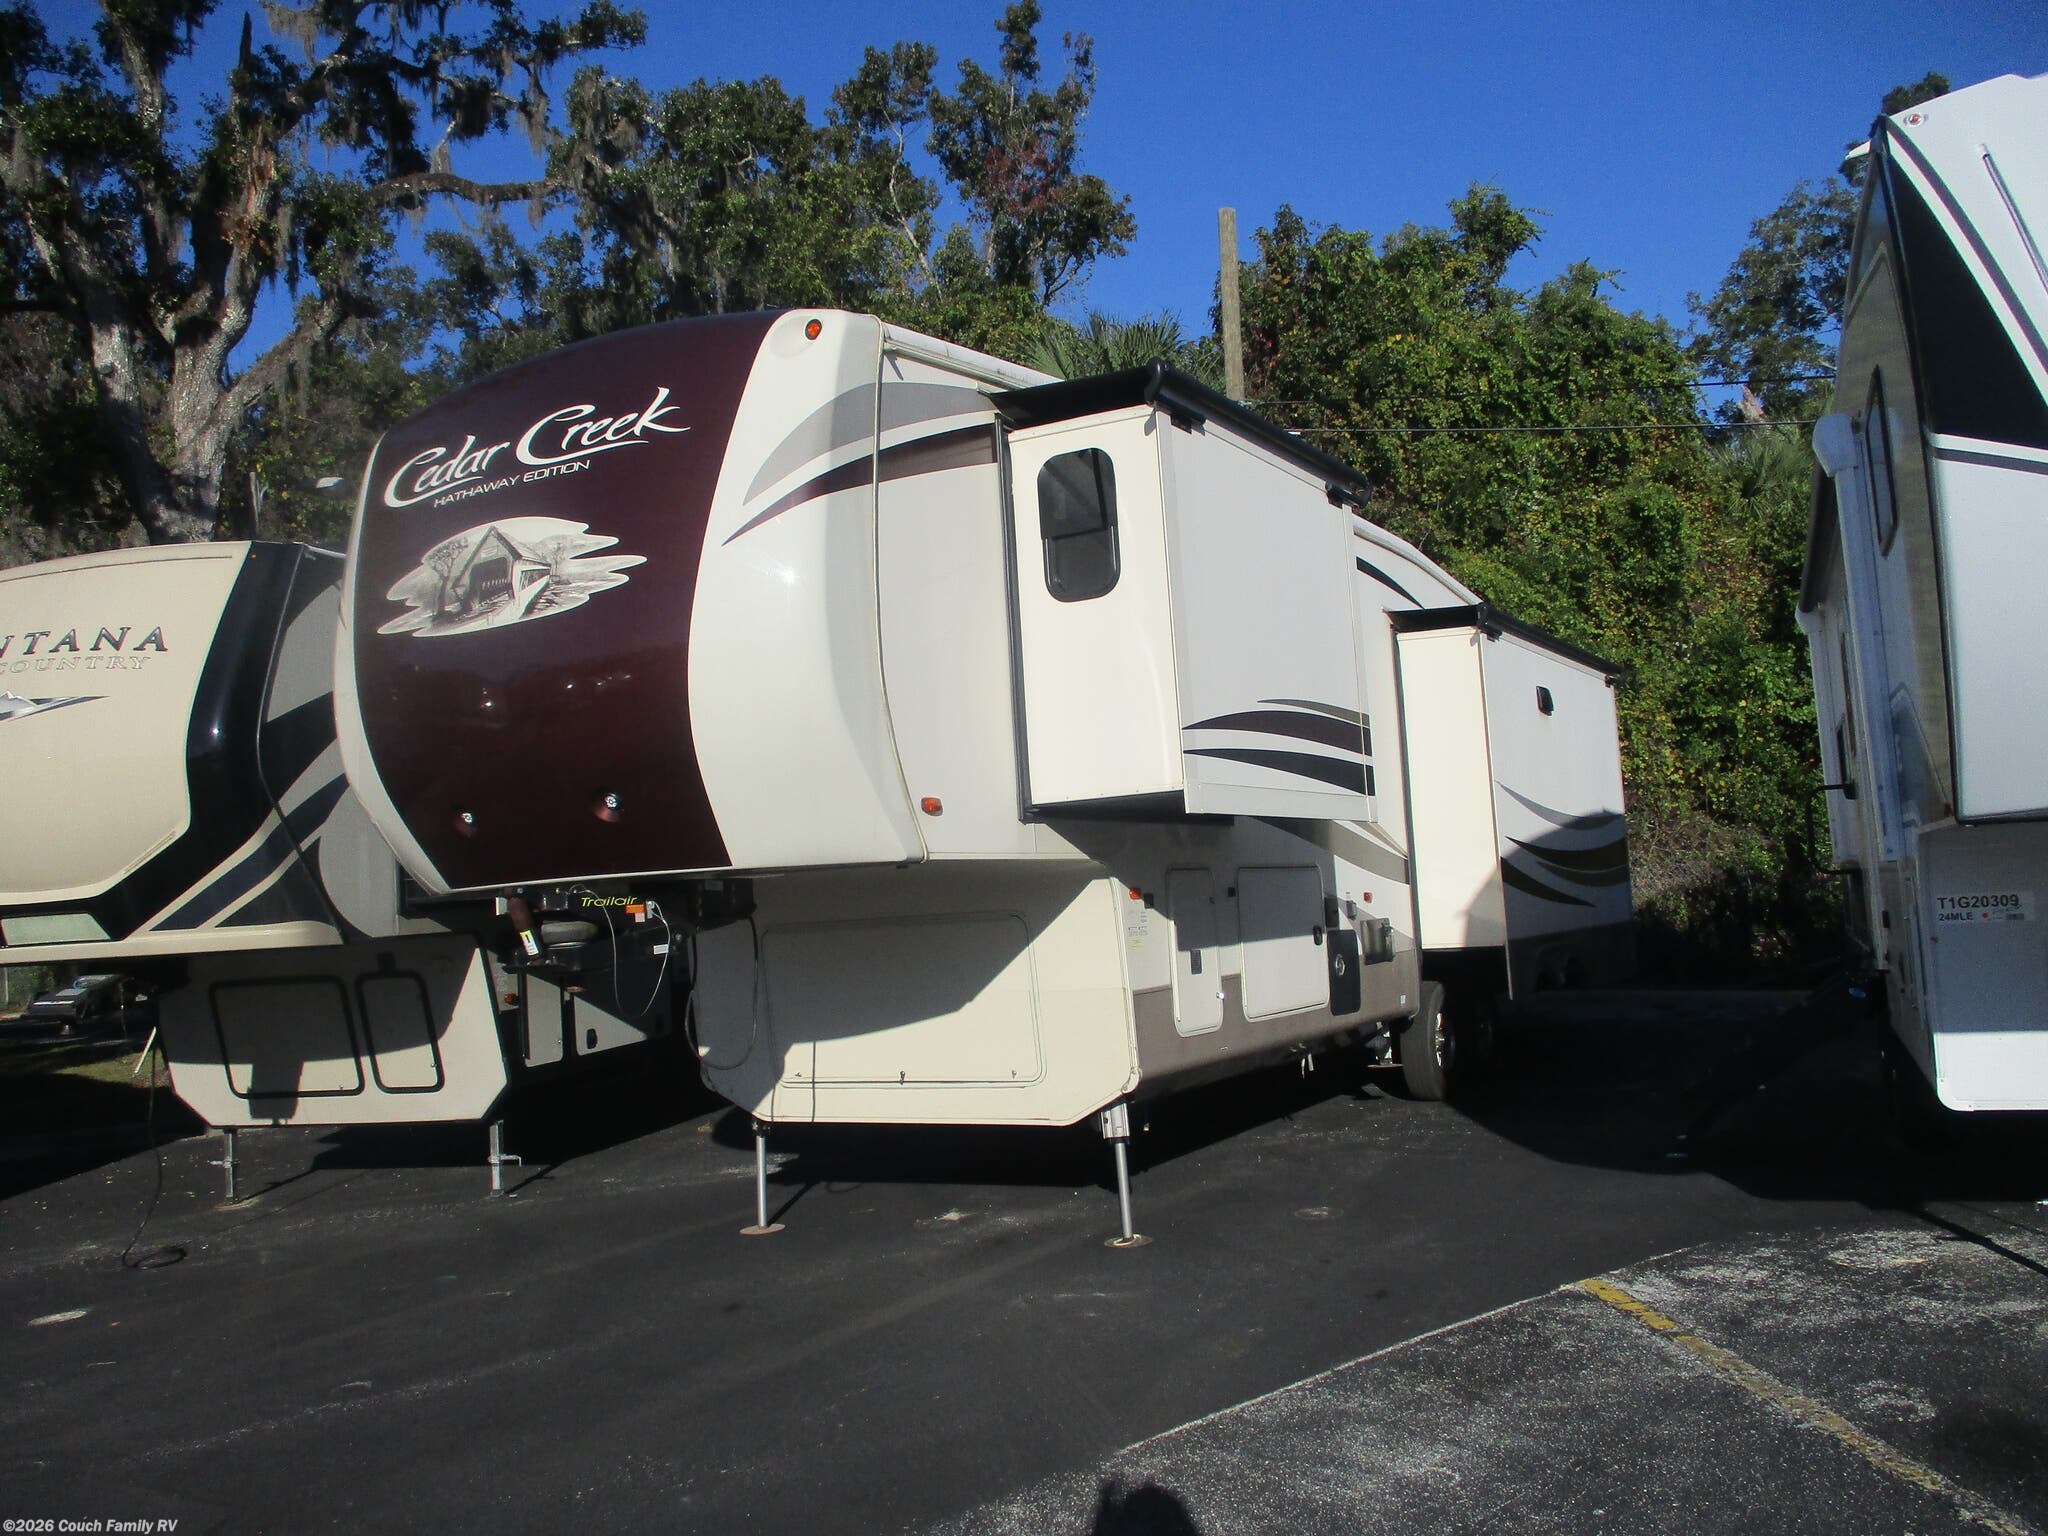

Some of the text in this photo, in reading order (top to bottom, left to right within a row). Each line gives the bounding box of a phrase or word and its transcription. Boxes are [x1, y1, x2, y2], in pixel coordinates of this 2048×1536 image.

[384, 386, 692, 508] Cedar Creek
[433, 459, 591, 508] HATHAWAY EDITION
[581, 896, 638, 908] Trailair
[1937, 894, 2020, 910] T1G20309
